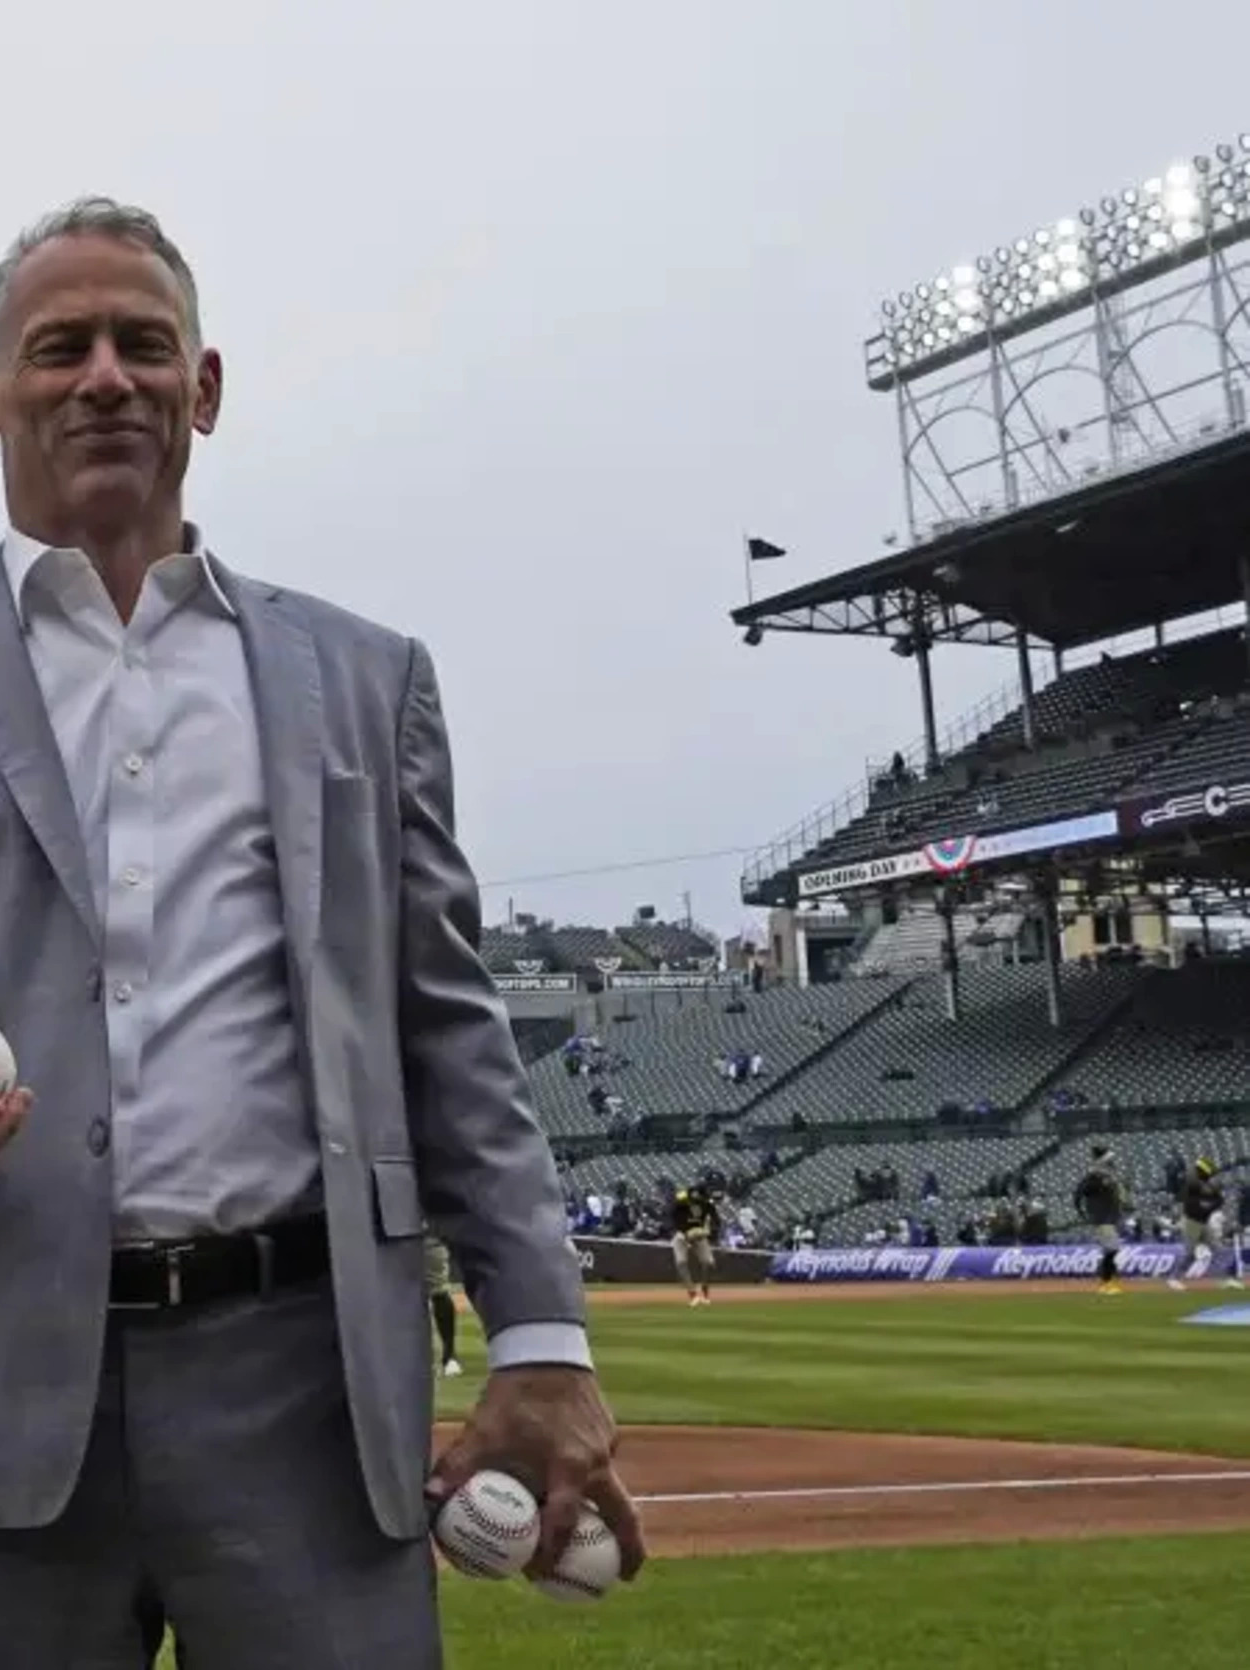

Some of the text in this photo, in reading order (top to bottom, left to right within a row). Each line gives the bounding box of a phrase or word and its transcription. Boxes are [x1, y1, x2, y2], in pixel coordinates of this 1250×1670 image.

[871, 859, 896, 878] DAY
[786, 1249, 930, 1280] Reynolds Wrap
[991, 1249, 1103, 1278] Reynolds
